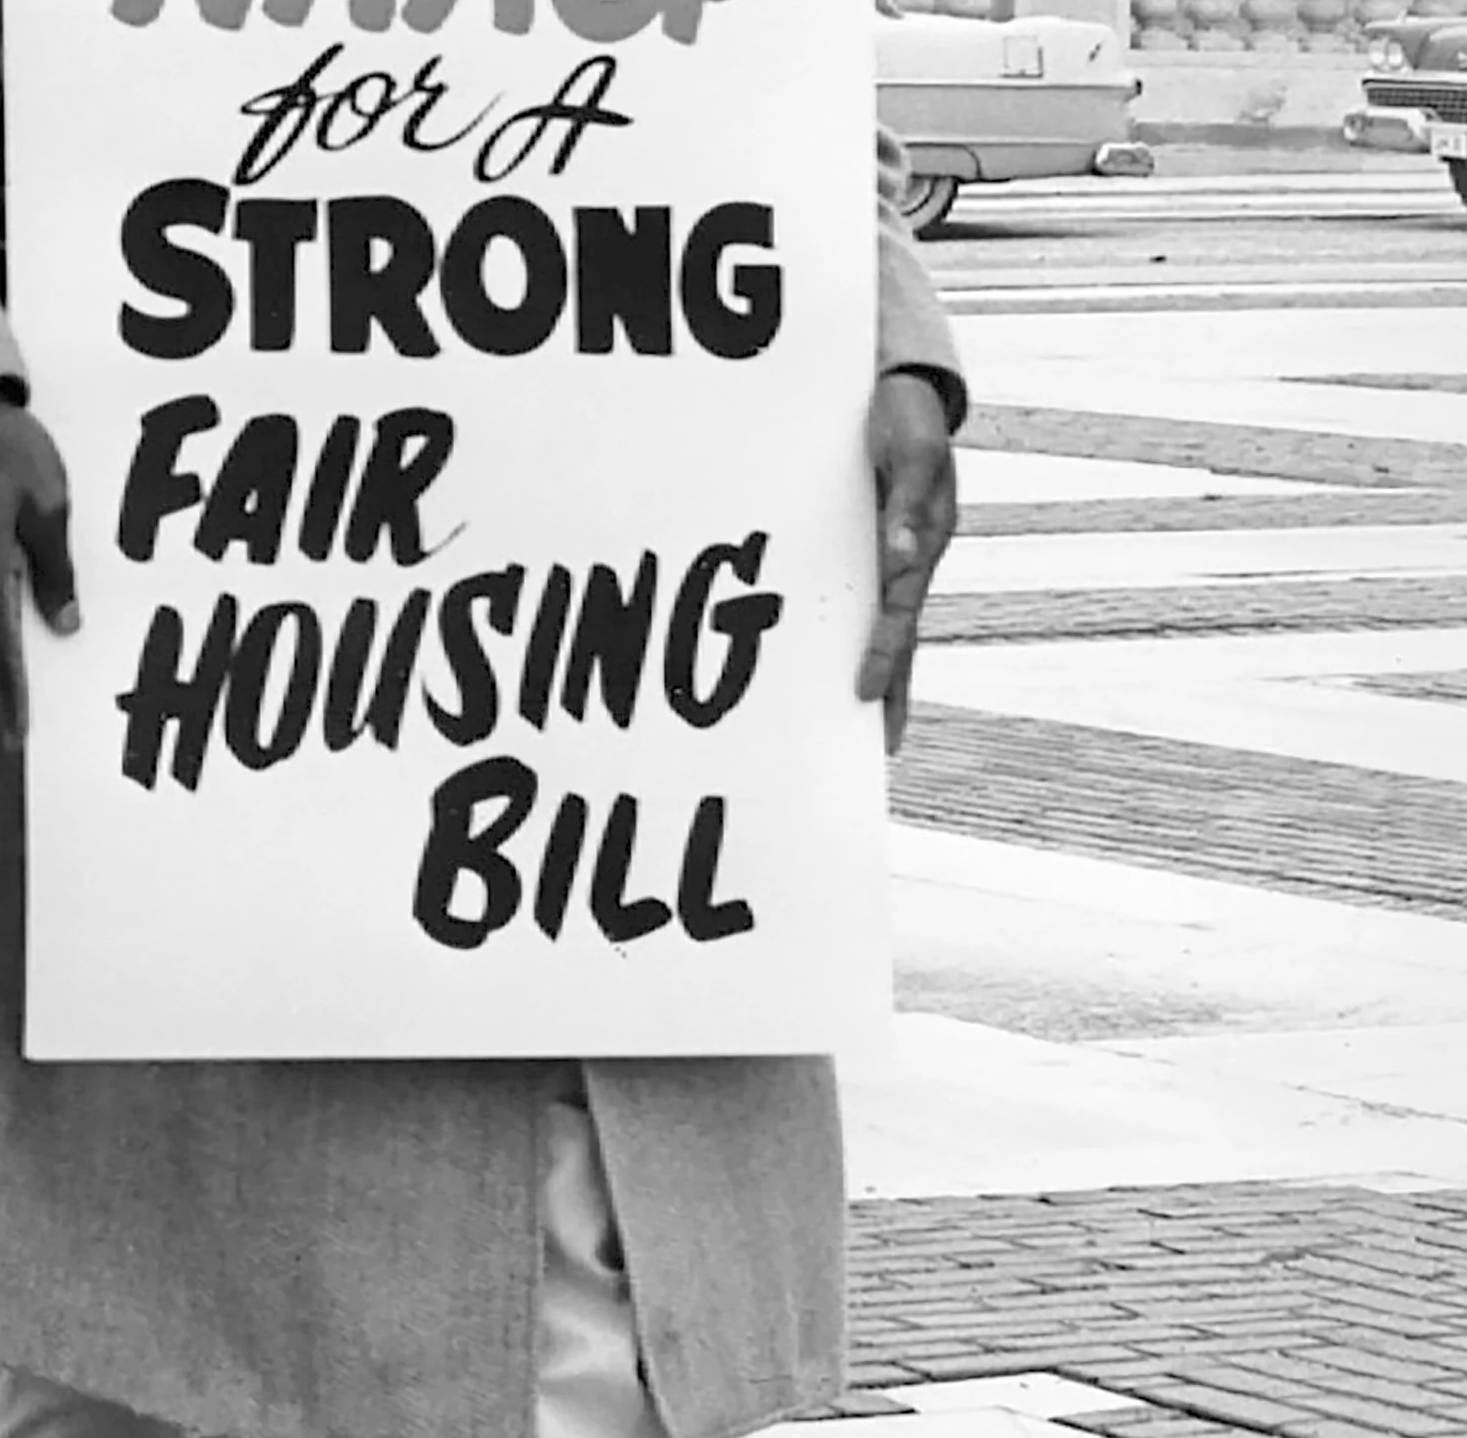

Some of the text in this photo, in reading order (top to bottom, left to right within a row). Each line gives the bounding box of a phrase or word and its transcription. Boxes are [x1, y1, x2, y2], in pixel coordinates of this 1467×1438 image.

[231, 43, 634, 187] for A
[118, 177, 783, 361] STRONG
[115, 393, 467, 569] FAIR
[114, 531, 785, 794] HOUSING
[412, 754, 756, 951] BILL
